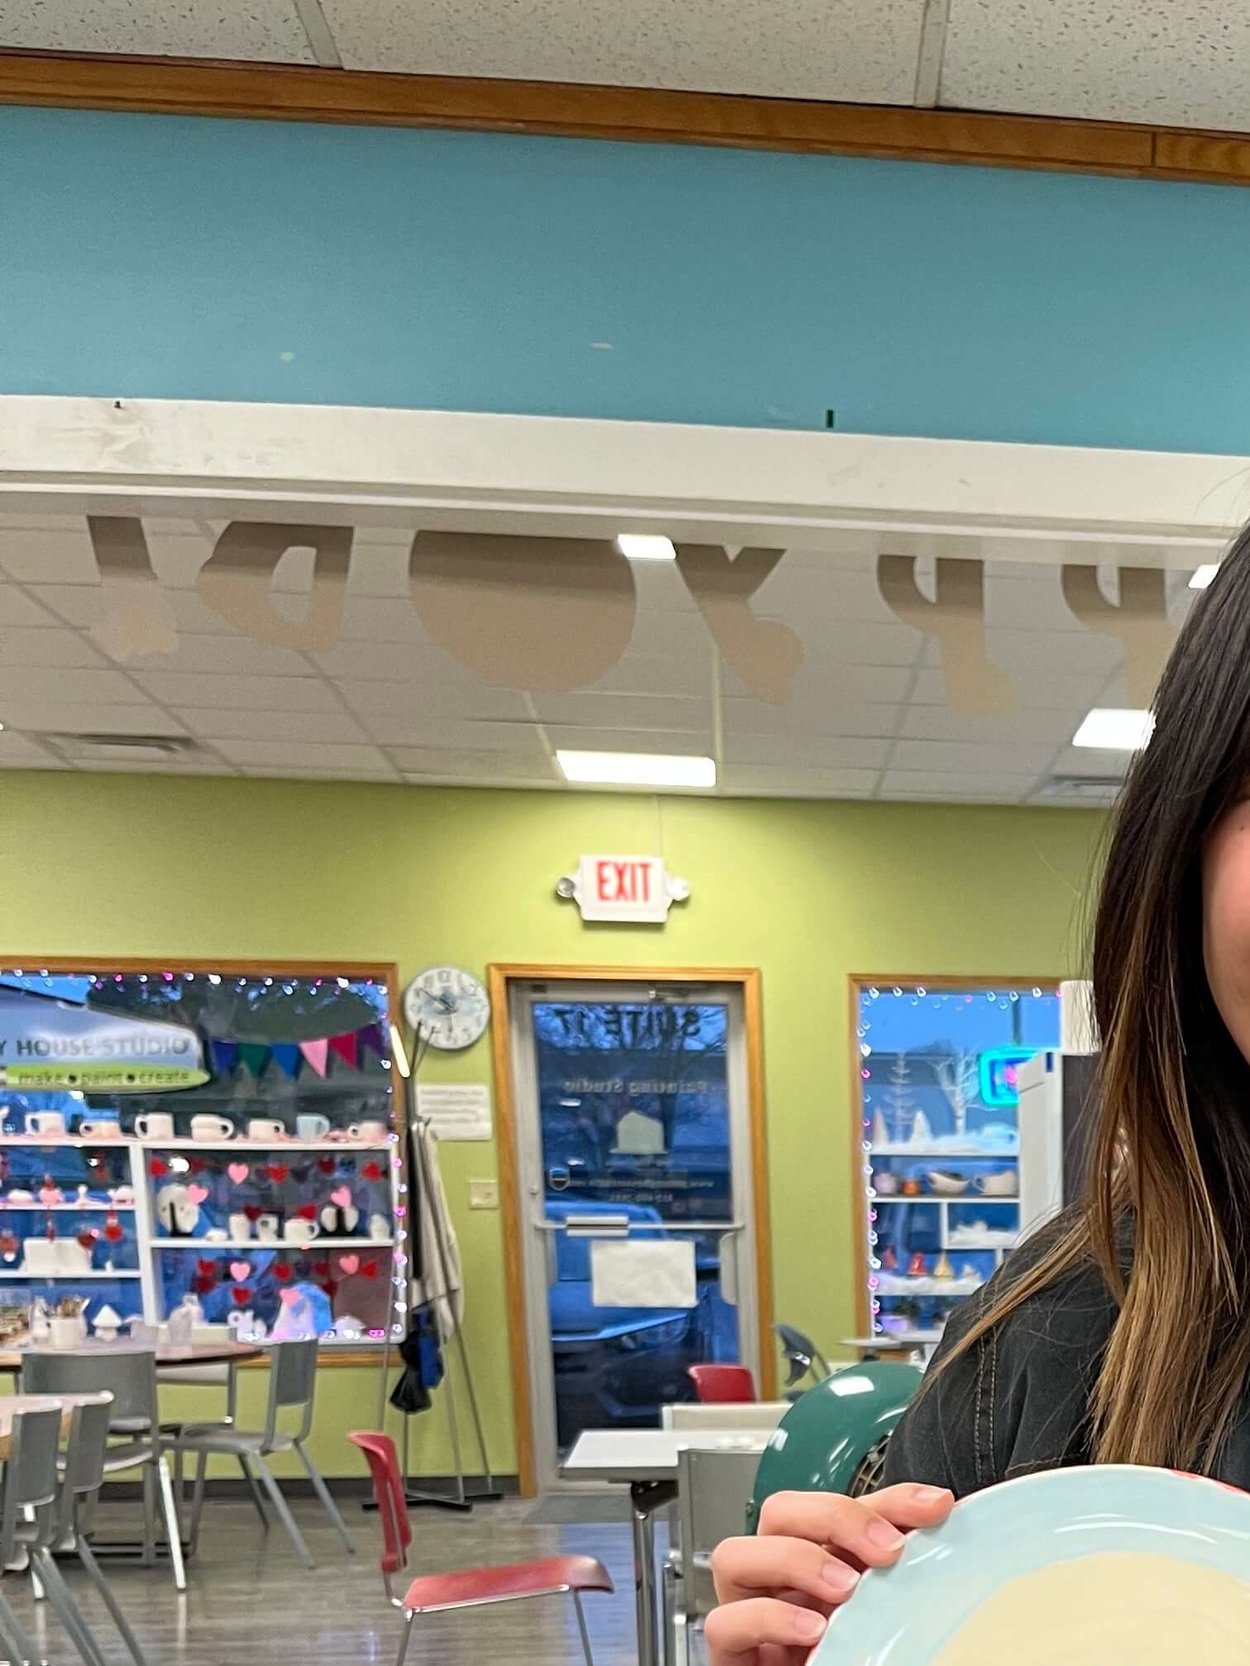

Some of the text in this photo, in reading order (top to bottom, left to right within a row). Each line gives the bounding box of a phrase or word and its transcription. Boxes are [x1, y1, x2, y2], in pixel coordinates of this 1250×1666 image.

[596, 861, 653, 902] EXIT
[16, 1039, 94, 1056] HOUSE
[101, 1037, 191, 1056] STUDIO
[18, 1071, 191, 1089] make paint create
